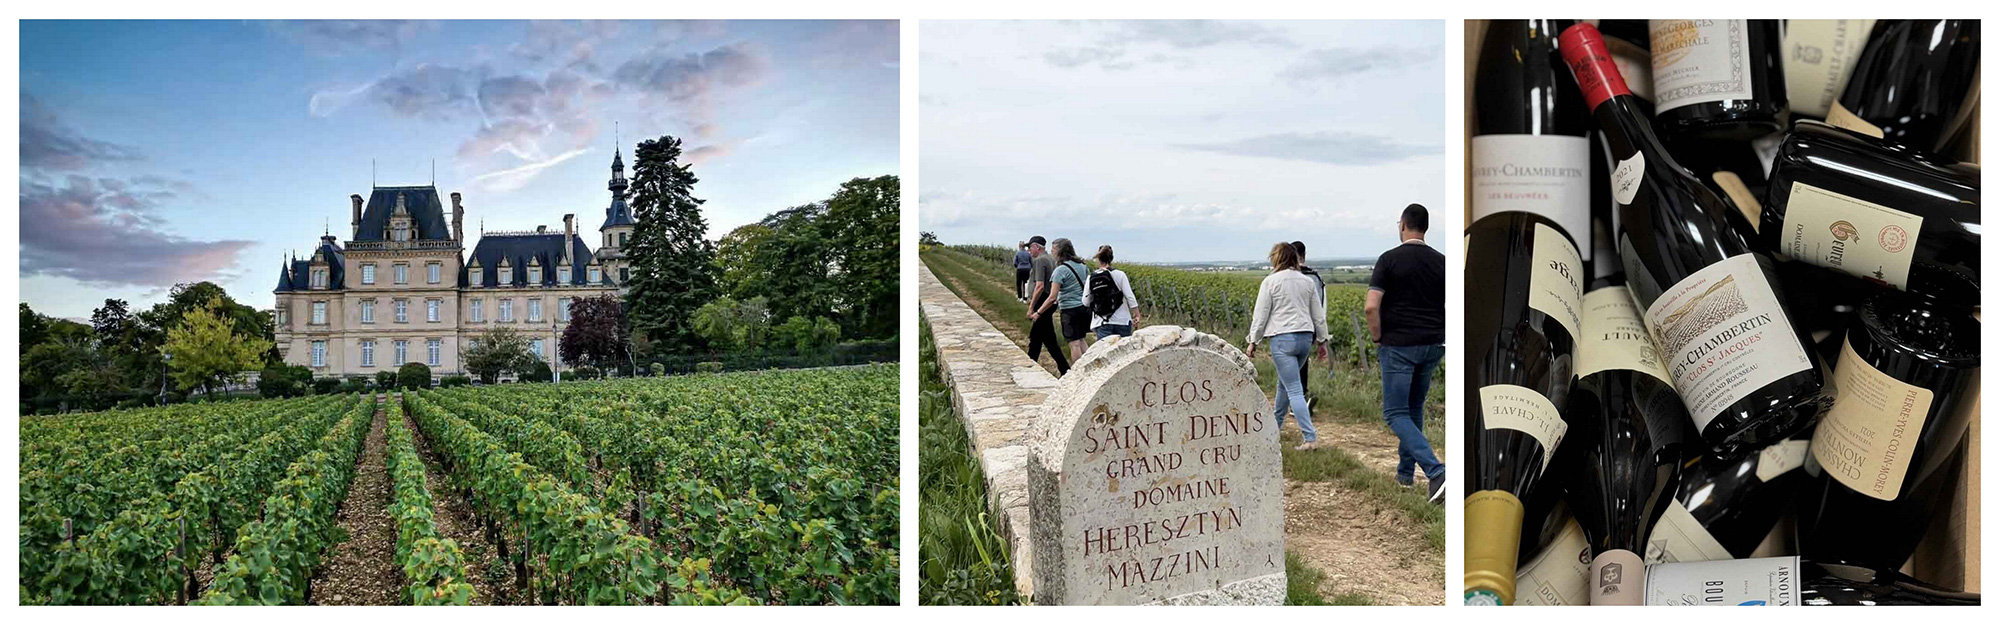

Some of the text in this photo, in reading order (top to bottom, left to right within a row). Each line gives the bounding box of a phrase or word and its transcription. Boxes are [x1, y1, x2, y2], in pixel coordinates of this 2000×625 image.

[1616, 165, 1632, 183] 2021
[1726, 363, 1759, 385] ROUSSEAU
[1142, 379, 1214, 408] CLOS
[1492, 406, 1535, 421] CHAVE
[1085, 412, 1265, 455] SAINT DENIS
[1861, 426, 1876, 439] 2021
[1873, 390, 1918, 495] PIERRE-YVES COLIN-MOREY
[1107, 444, 1242, 479] GRAND CRU
[1134, 477, 1231, 509] DOMAINE
[1083, 506, 1243, 557] HERESZTYN
[1107, 546, 1221, 591] MAZZINI
[1778, 566, 1790, 606] ARNOUX
